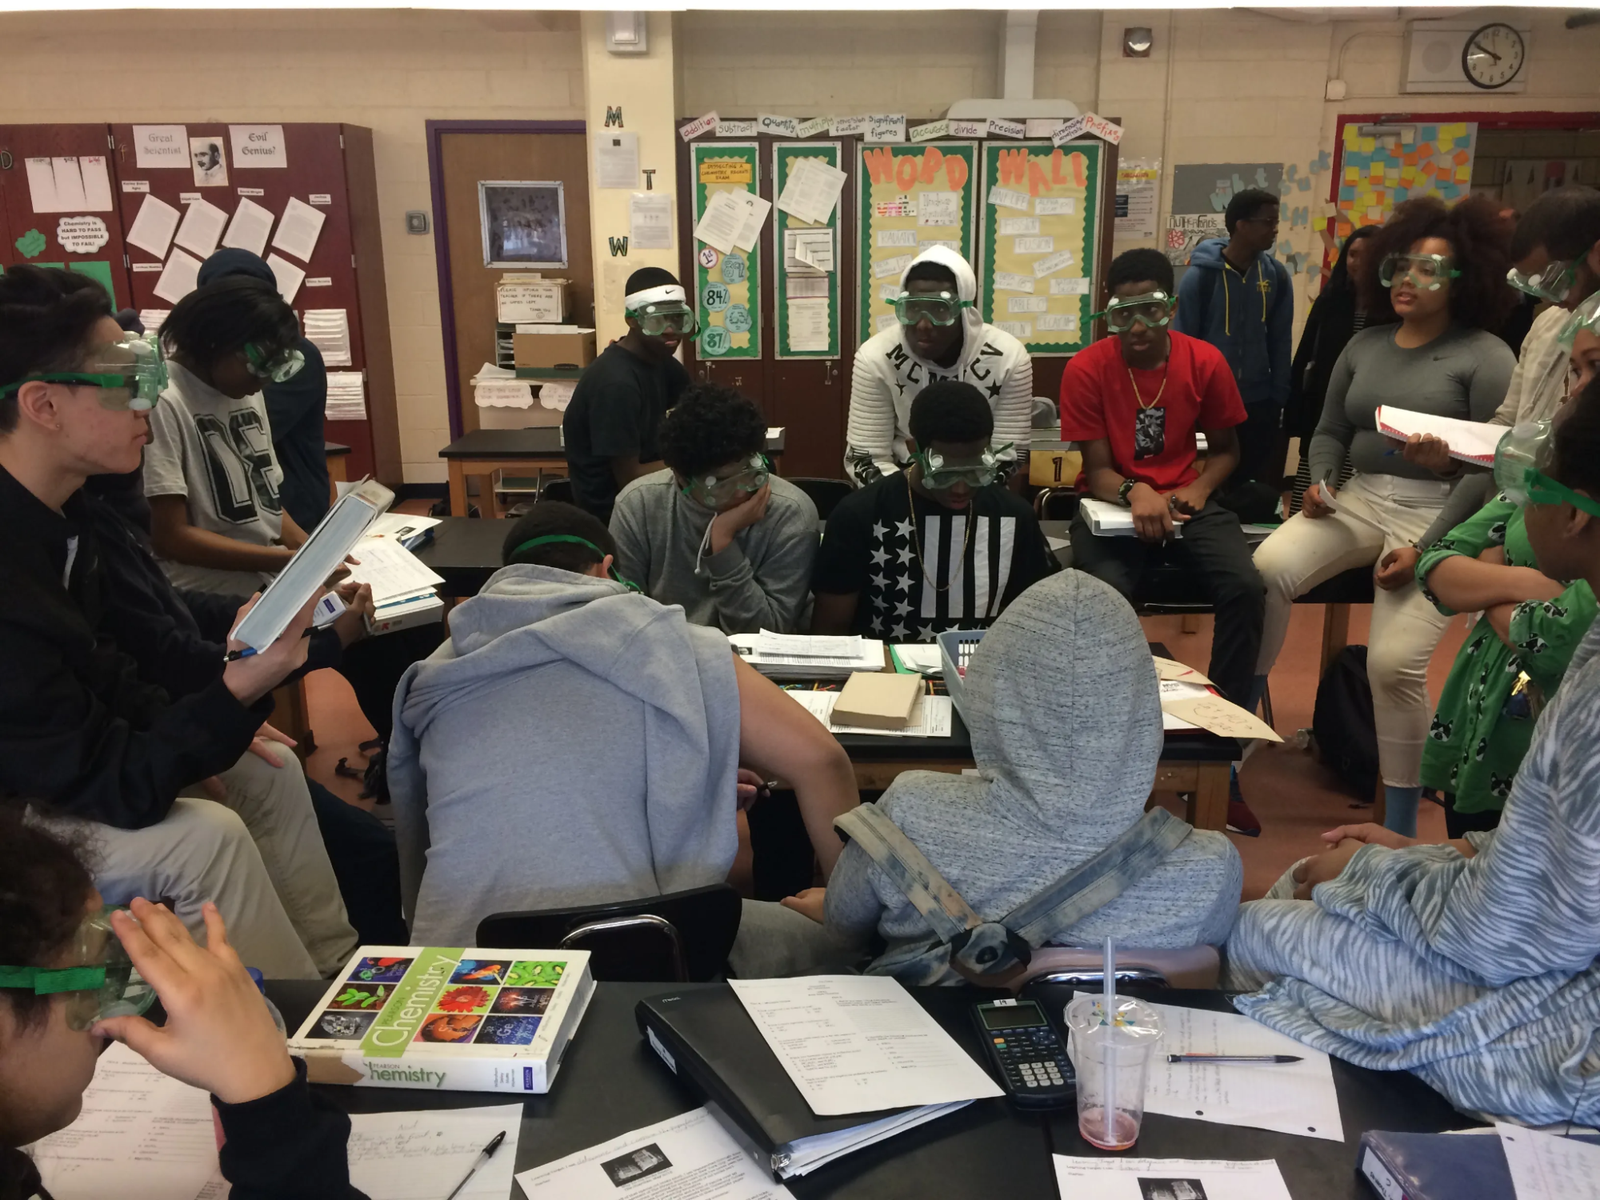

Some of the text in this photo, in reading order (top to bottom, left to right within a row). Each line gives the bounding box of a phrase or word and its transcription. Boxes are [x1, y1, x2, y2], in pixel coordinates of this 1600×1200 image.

[604, 105, 624, 128] M
[799, 115, 834, 135] multiply
[248, 132, 268, 142] Evil
[683, 117, 716, 137] addition
[718, 122, 754, 134] subtract
[870, 128, 898, 140] figures
[911, 122, 949, 139] accuracy
[954, 124, 978, 135] divide
[988, 120, 1024, 135] Precision
[642, 169, 656, 190] T
[863, 146, 969, 191] WORD
[998, 148, 1088, 197] WALL
[608, 236, 628, 257] W
[706, 288, 728, 305] 84%
[1052, 456, 1063, 482] 1
[372, 955, 462, 1047] Chemistry
[497, 1023, 514, 1037] Ge
[363, 1061, 446, 1088] hemistry
